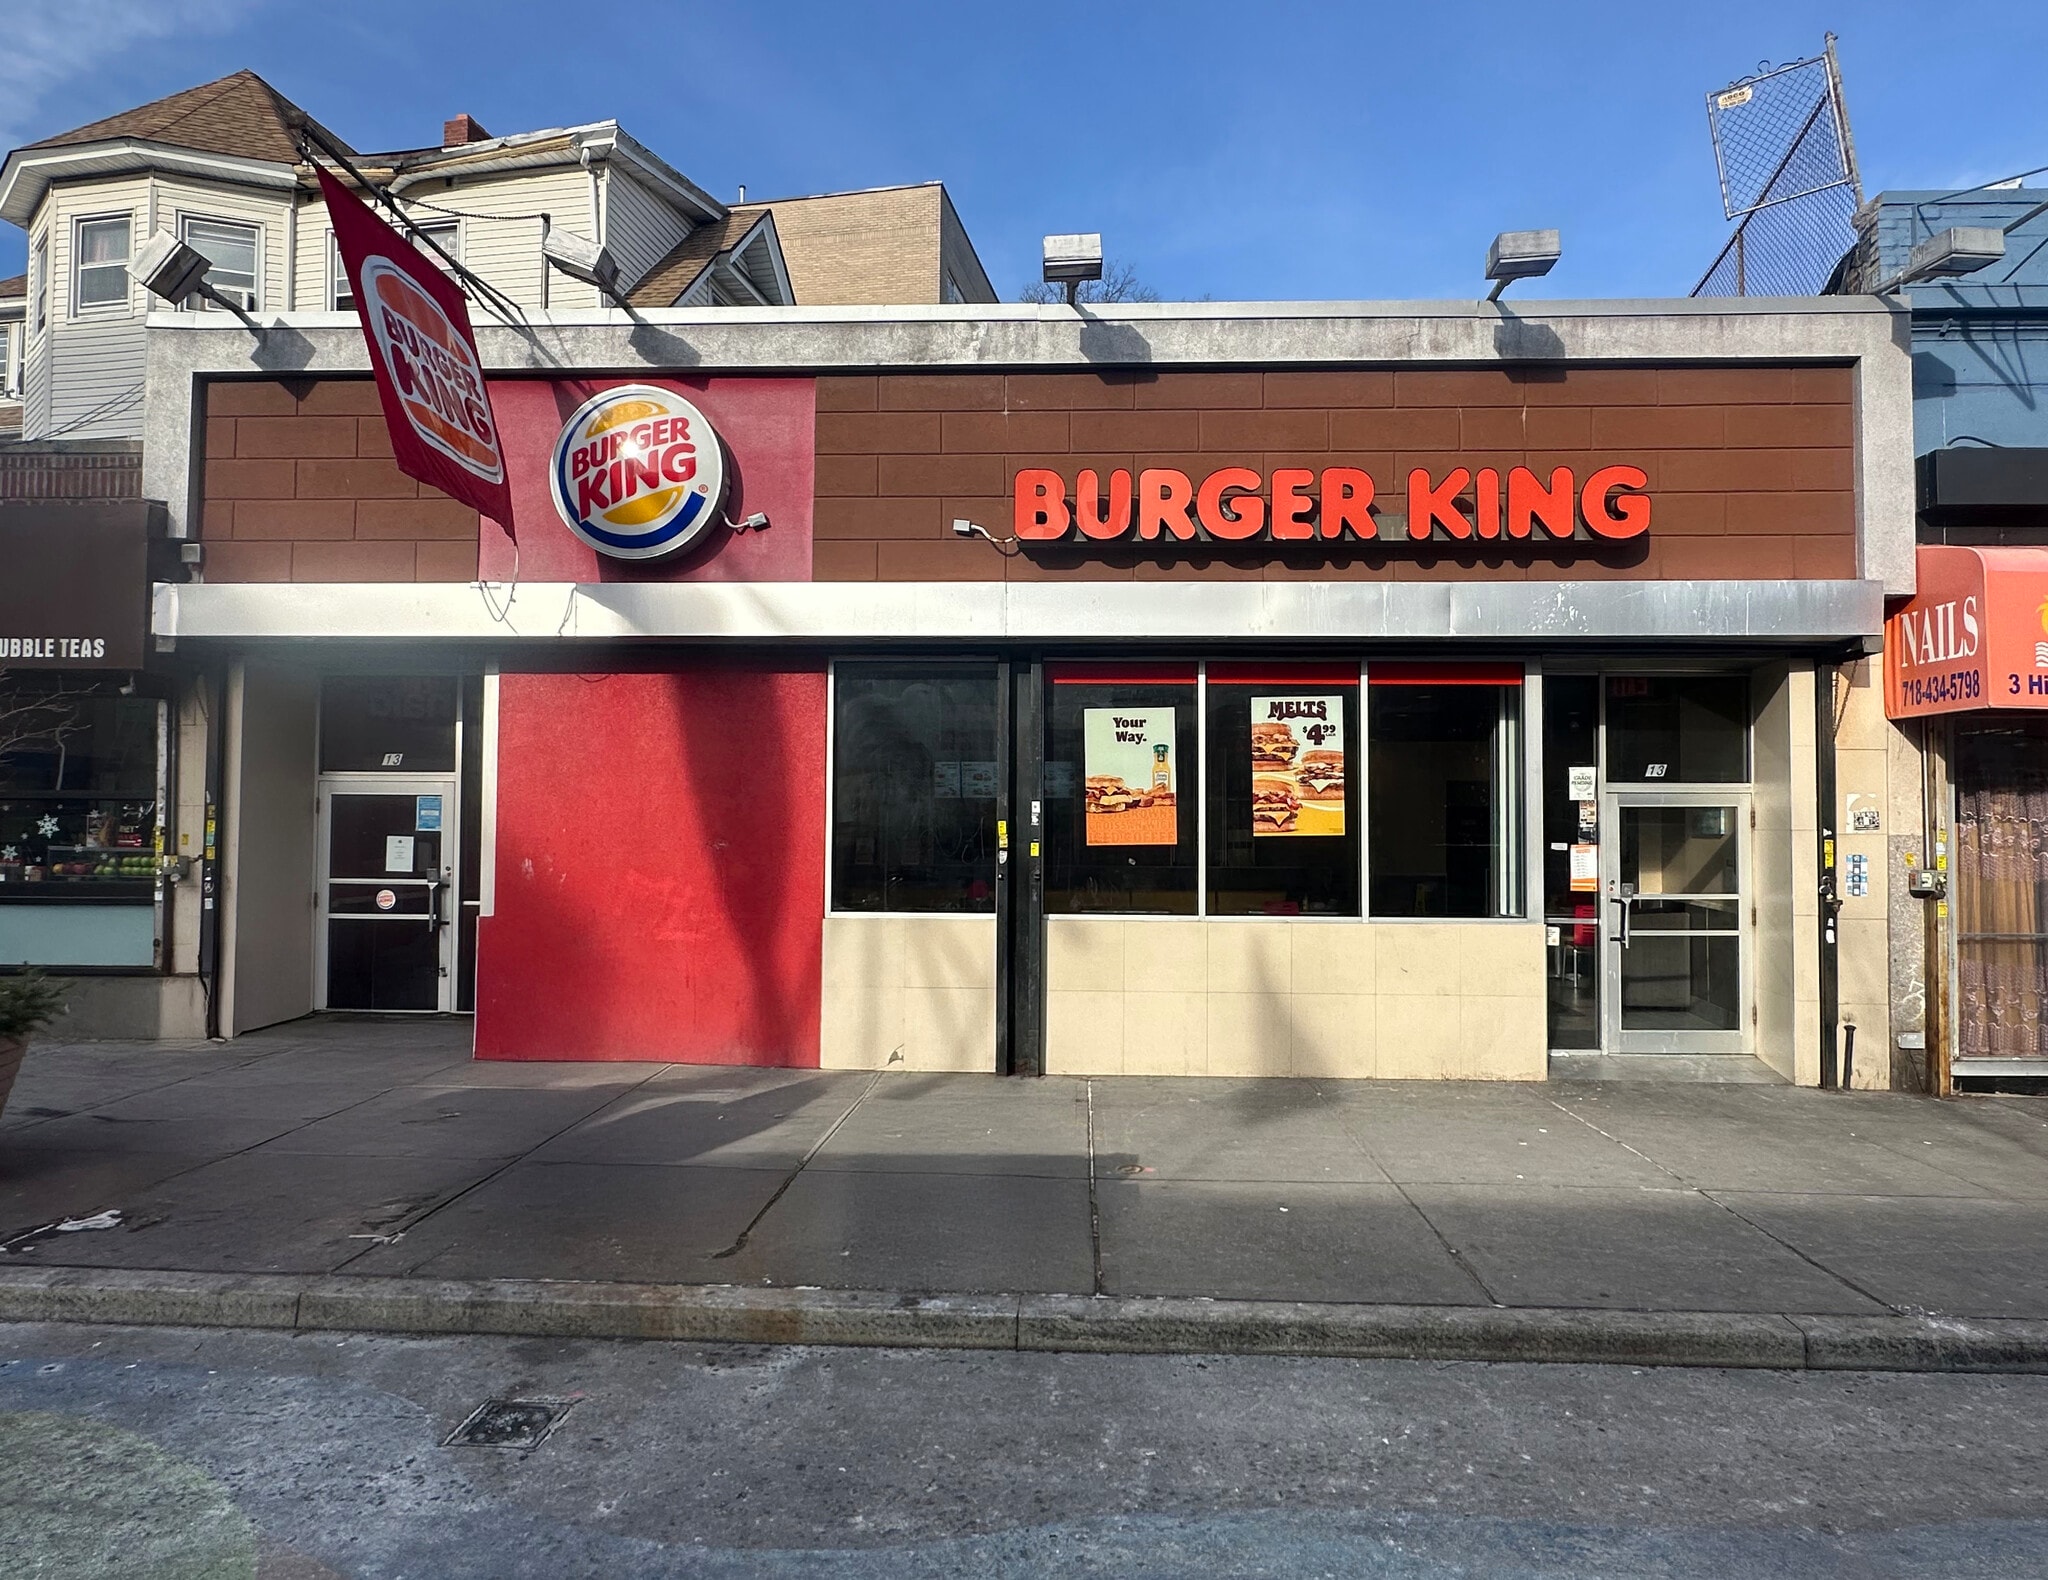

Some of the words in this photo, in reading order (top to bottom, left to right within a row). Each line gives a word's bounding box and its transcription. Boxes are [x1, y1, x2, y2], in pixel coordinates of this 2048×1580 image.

[381, 305, 482, 401] BURGER
[391, 343, 492, 445] KING
[572, 417, 691, 481] BURGER
[578, 442, 697, 522] KING
[1014, 467, 1378, 541] BURGER
[1407, 465, 1651, 540] KING
[1901, 595, 1979, 668] NAILS
[0, 638, 55, 658] UBBLE
[60, 638, 105, 658] TEAS
[1902, 669, 1980, 706] 718-434-5798
[2008, 674, 2021, 694] 3
[1112, 717, 1147, 728] Your
[1267, 700, 1327, 721] MELTS
[1115, 731, 1147, 745] Way.
[385, 754, 402, 765] 13
[1648, 765, 1666, 776] 13
